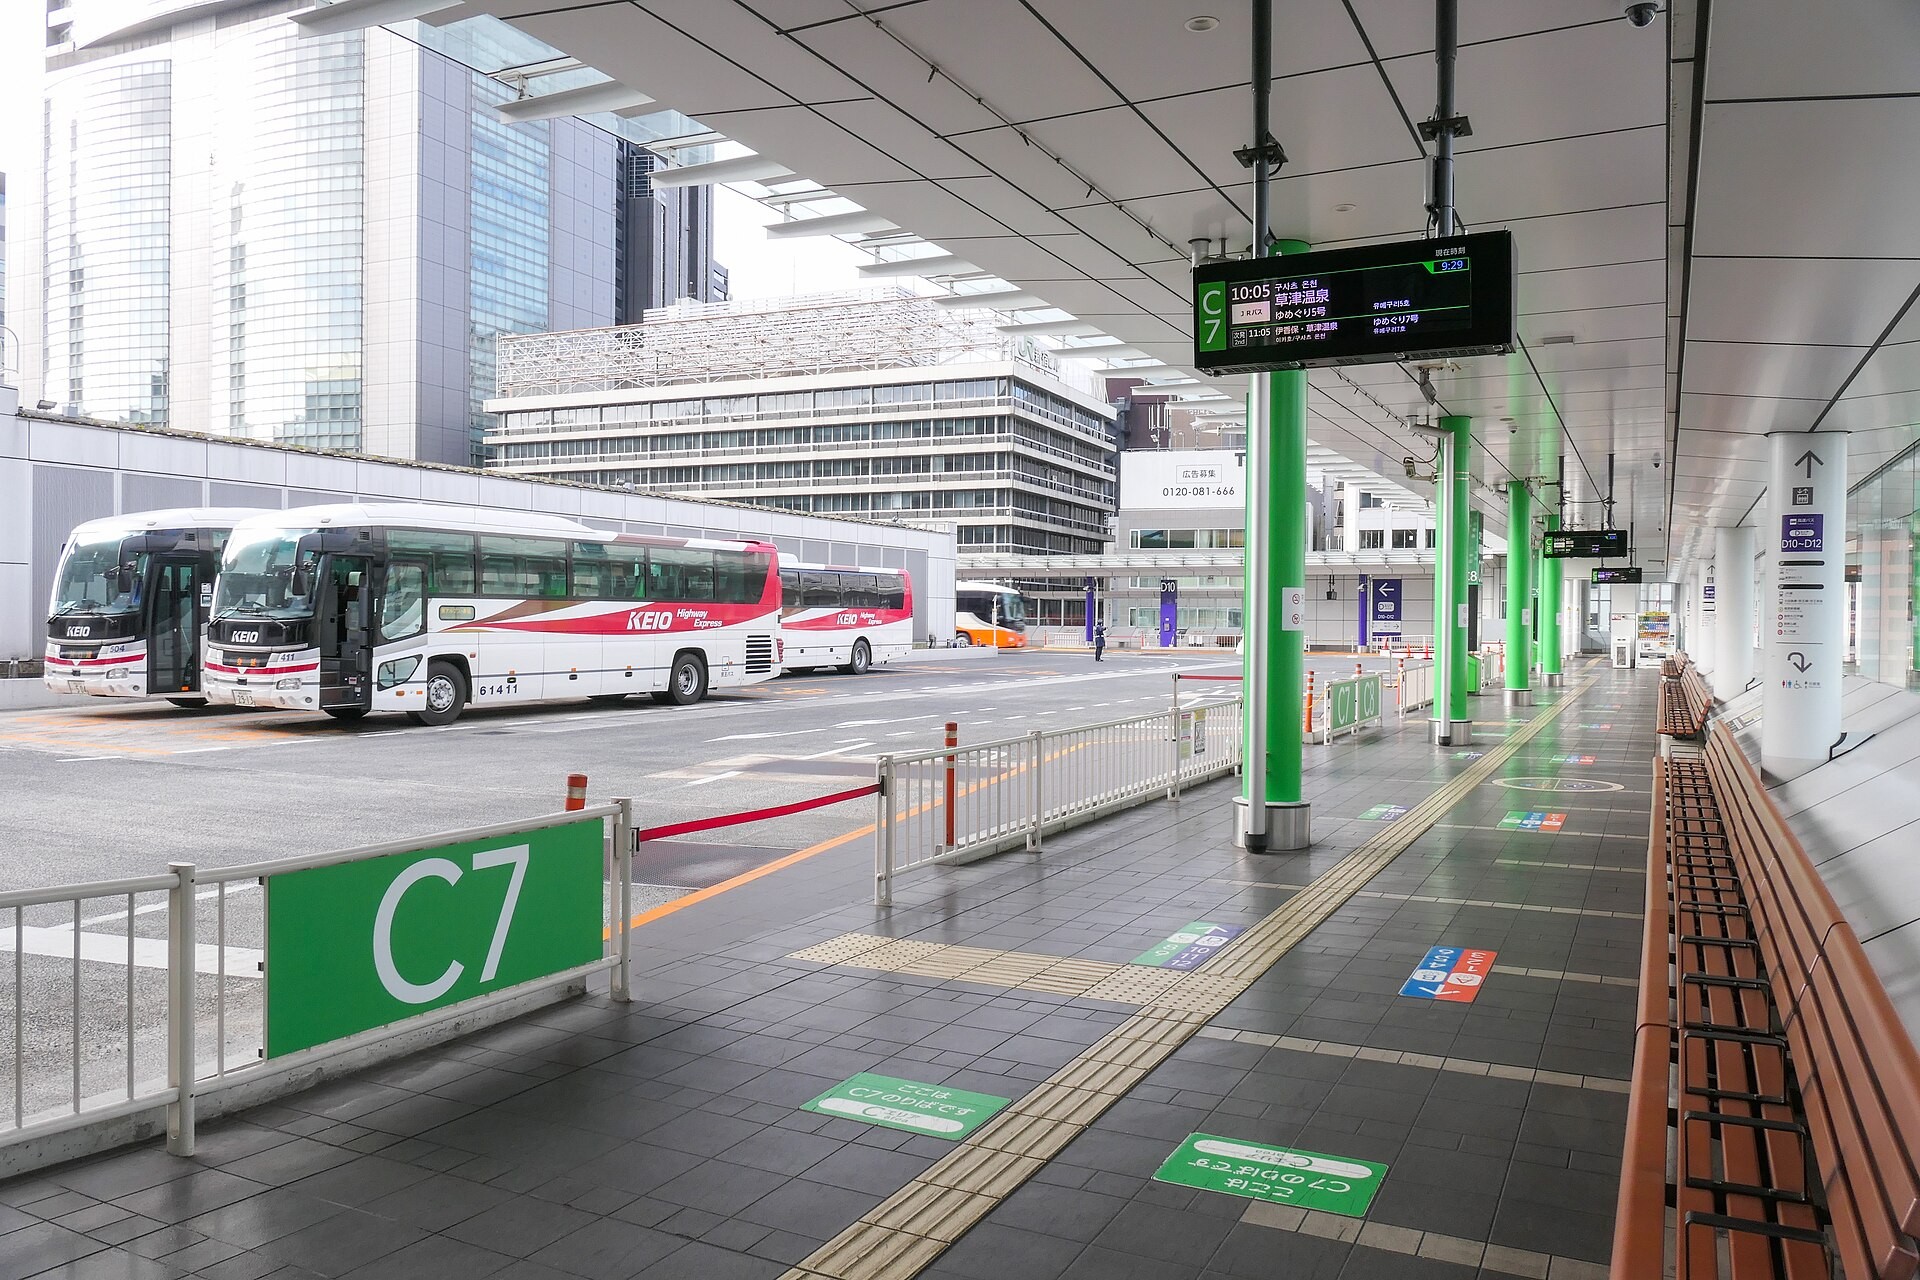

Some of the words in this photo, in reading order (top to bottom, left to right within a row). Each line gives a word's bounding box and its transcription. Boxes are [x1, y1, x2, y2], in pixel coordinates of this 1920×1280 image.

[1441, 260, 1464, 271] 9:29
[1231, 284, 1271, 301] 10:05
[1274, 289, 1330, 307] 草津温泉
[1275, 306, 1327, 321] ゆめぐり5号
[1373, 313, 1420, 327] ゆめぐり7号
[1248, 328, 1271, 338] 11:05
[1182, 469, 1216, 479] 広告募集
[1162, 486, 1235, 497] 0120-081-666
[1160, 581, 1177, 593] D10
[626, 611, 673, 631] KEIO
[676, 608, 708, 620] Highway
[693, 618, 723, 629] Express
[836, 613, 858, 625] KEIO
[859, 611, 876, 620] Highway
[66, 626, 91, 638] KEIO
[231, 630, 259, 644] KEIO
[110, 644, 126, 653] 504
[280, 653, 296, 662] 411
[480, 684, 518, 696] 61411
[1363, 680, 1375, 717] C8
[1337, 686, 1350, 725] C7
[372, 843, 530, 1004] C7
[1190, 946, 1210, 954] 10
[1171, 960, 1192, 968] 12
[898, 1084, 953, 1100] ここは
[883, 1115, 909, 1123] area
[1224, 1177, 1294, 1198] ここは
